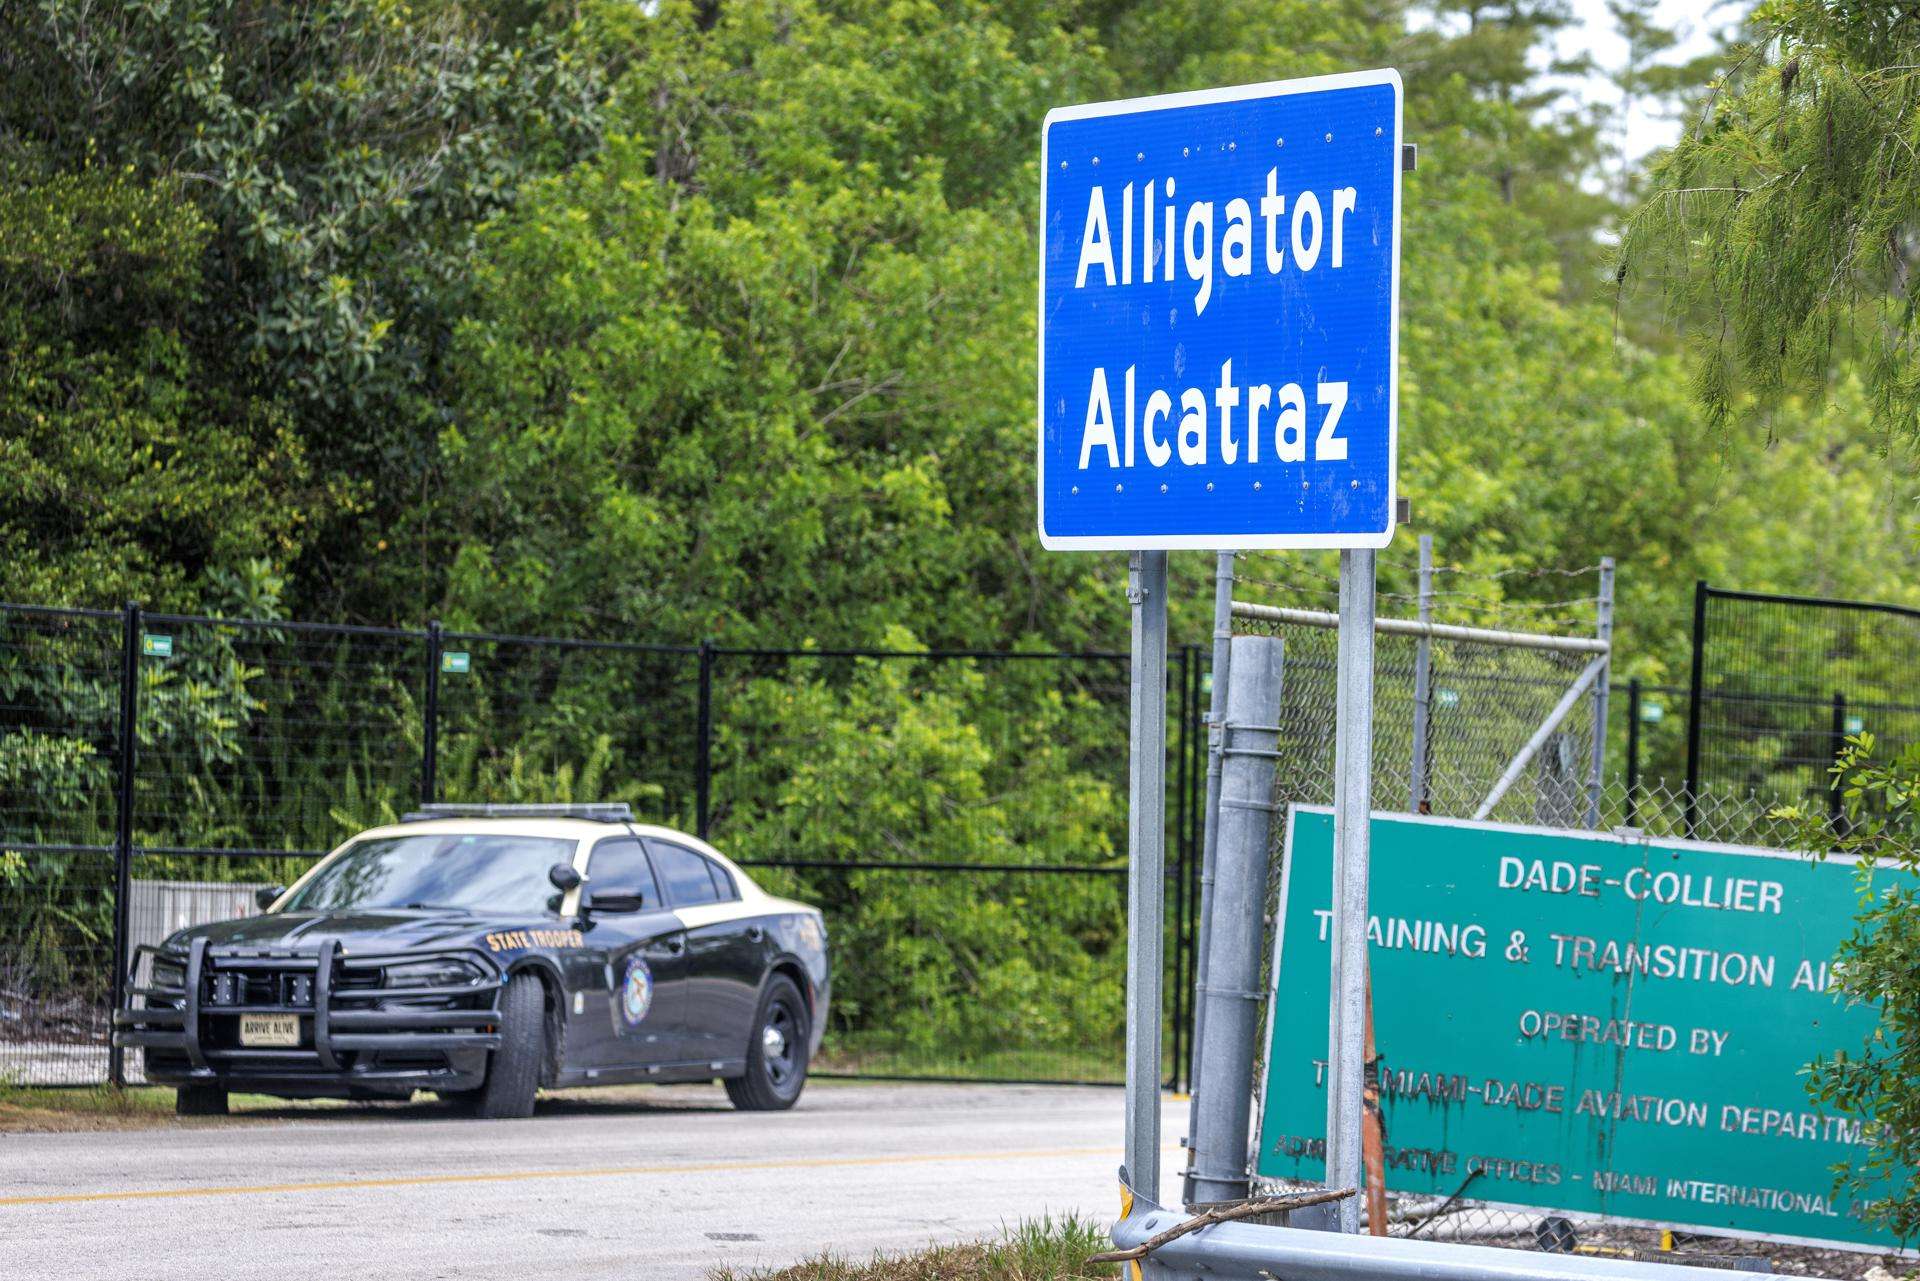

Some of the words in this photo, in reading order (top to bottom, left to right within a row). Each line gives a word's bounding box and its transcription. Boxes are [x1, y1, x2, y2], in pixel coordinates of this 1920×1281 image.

[1075, 166, 1357, 317] Alligator
[1078, 357, 1349, 470] Alcatraz
[1498, 855, 1785, 915] DADE-COLLIER
[485, 930, 531, 952] STATE
[530, 929, 584, 949] TROOPER
[1313, 909, 1487, 958] TAINING
[1504, 930, 1529, 963] &
[1550, 934, 1776, 987] TRANSITION
[244, 1021, 270, 1034] ARRIVE
[273, 1021, 294, 1035] ALIVE
[1519, 1009, 1677, 1052] OPERATED
[1690, 1028, 1730, 1056] BY
[1382, 1066, 1565, 1114] MIAMI-DADE
[1575, 1089, 1707, 1129] AVIATION
[1467, 1155, 1561, 1185] OFFICES
[1593, 1171, 1658, 1197] MIAMI
[1667, 1178, 1839, 1217] INTERNATIONAL
